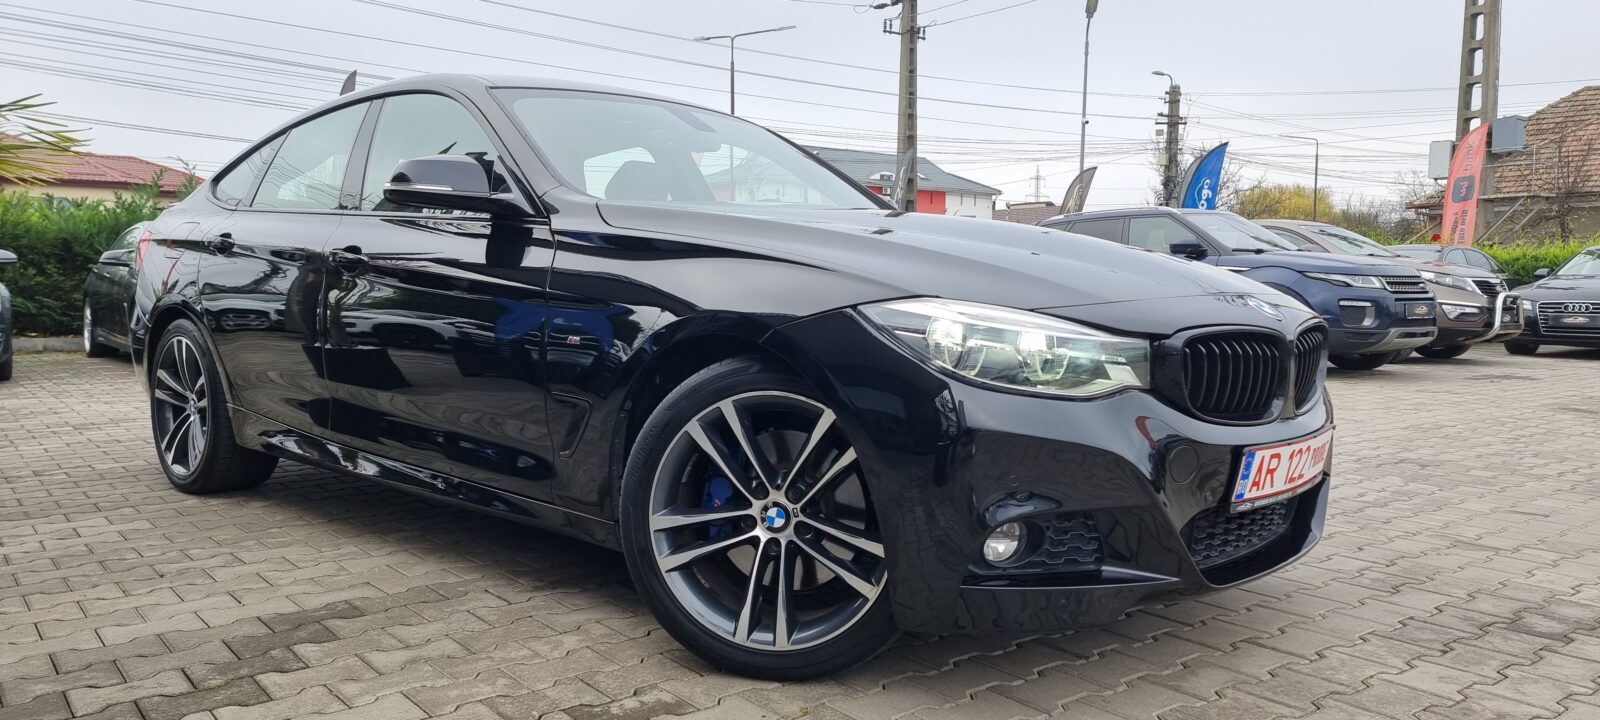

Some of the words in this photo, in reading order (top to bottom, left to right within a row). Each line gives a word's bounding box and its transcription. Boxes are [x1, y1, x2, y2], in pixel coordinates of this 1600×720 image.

[1464, 142, 1475, 172] bank
[1249, 453, 1282, 492] AR
[1284, 445, 1311, 485] 122
[1237, 479, 1248, 495] RO
